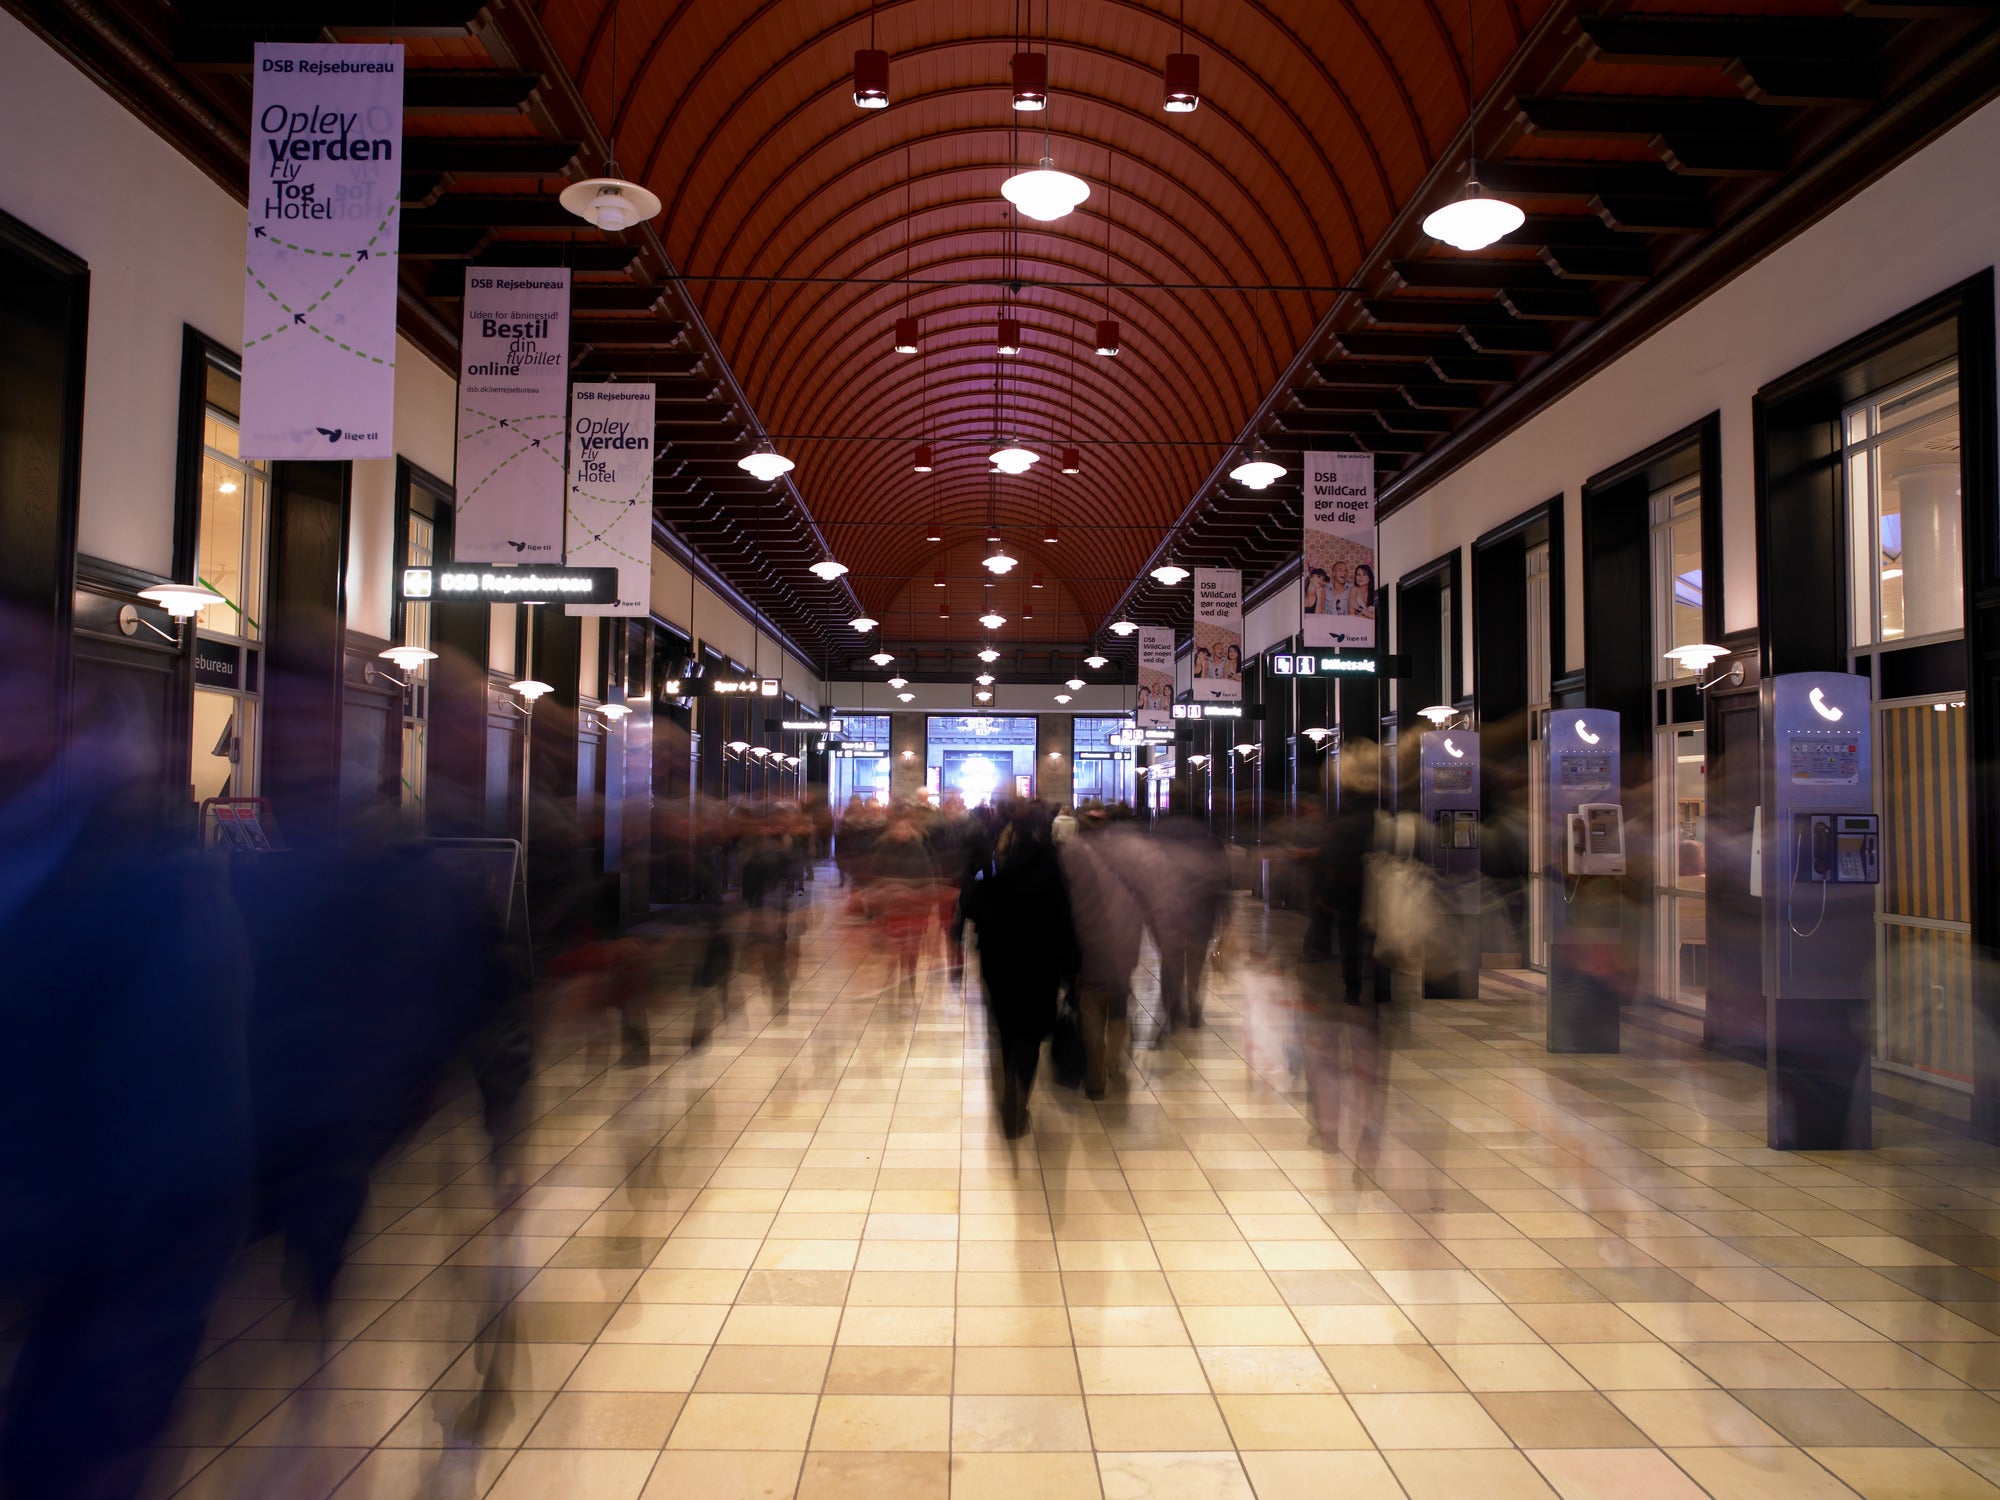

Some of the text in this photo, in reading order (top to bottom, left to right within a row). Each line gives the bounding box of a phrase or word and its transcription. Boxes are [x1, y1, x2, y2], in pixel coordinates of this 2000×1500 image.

[262, 59, 394, 76] DSB Rejsebureau
[270, 158, 302, 182] Fly
[272, 180, 315, 203] Tog
[264, 197, 332, 220] Hotel
[471, 279, 564, 291] DSB Rejsebureau
[469, 311, 493, 319] Uden
[495, 311, 507, 319] for
[482, 319, 548, 338] Bestil
[509, 336, 537, 353] din
[505, 351, 562, 367] flybillet
[467, 362, 520, 376] online
[577, 392, 650, 402] DSB Rejsebureau
[344, 432, 378, 441] lige til
[581, 447, 599, 461] Fly
[583, 459, 606, 473] Tog
[578, 469, 616, 483] Hotel
[1314, 472, 1337, 482] DSB
[1314, 485, 1367, 496] WildCard
[1314, 500, 1369, 511] gør noget
[1314, 512, 1356, 524] ved dig
[440, 573, 592, 593] DSB Rejsebureau
[1200, 582, 1217, 590] DSB
[1200, 591, 1237, 599] WildCard
[1215, 601, 1238, 609] noget
[1200, 609, 1229, 618] ved dig
[194, 654, 233, 675] ebureau
